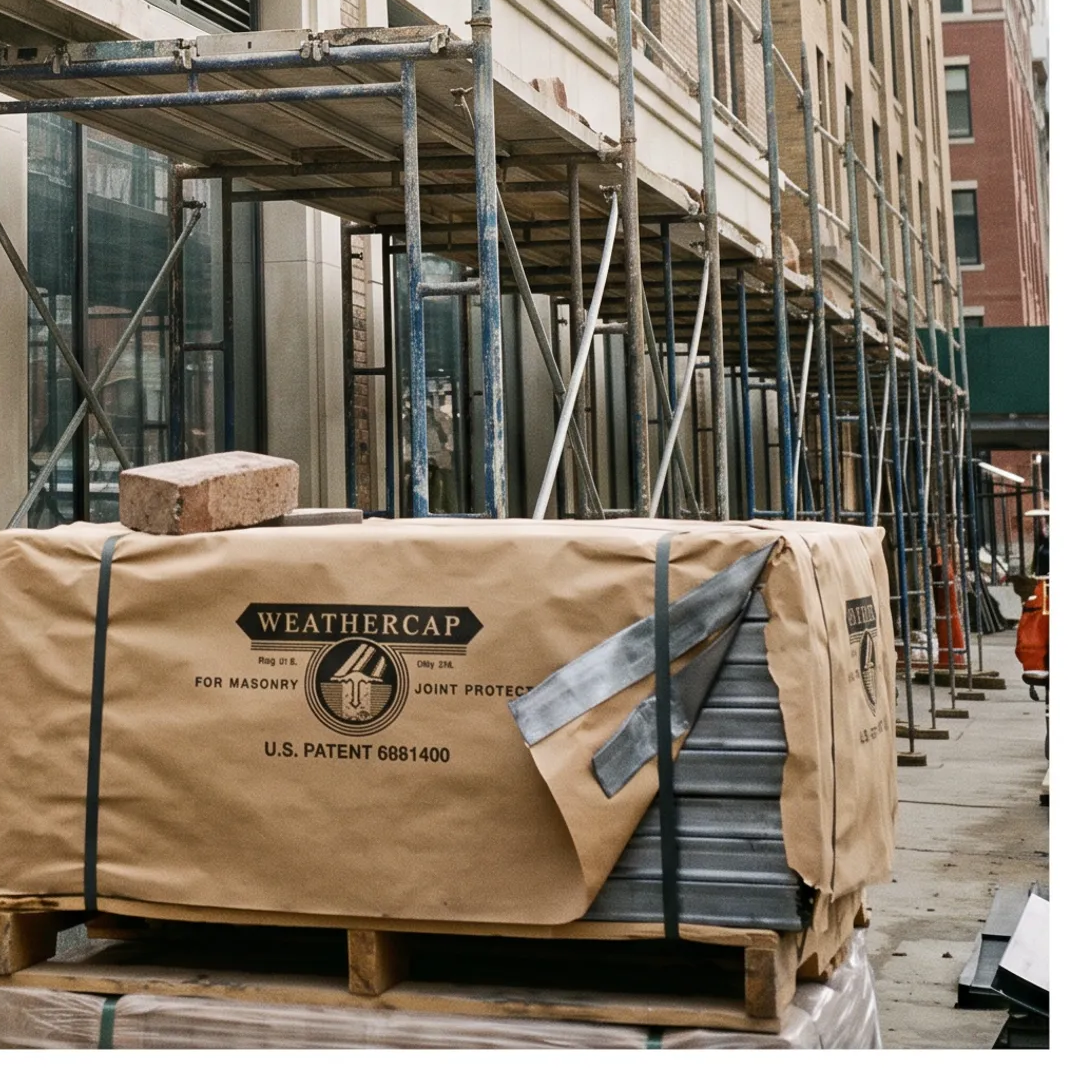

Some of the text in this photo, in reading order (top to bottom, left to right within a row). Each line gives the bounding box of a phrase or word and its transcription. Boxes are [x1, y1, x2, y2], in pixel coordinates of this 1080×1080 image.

[257, 612, 461, 636] WEATHERCAP
[195, 676, 299, 690] FOR MASONRY
[414, 683, 458, 695] JOINT
[264, 741, 451, 763] U.S. PATENT 6881400
